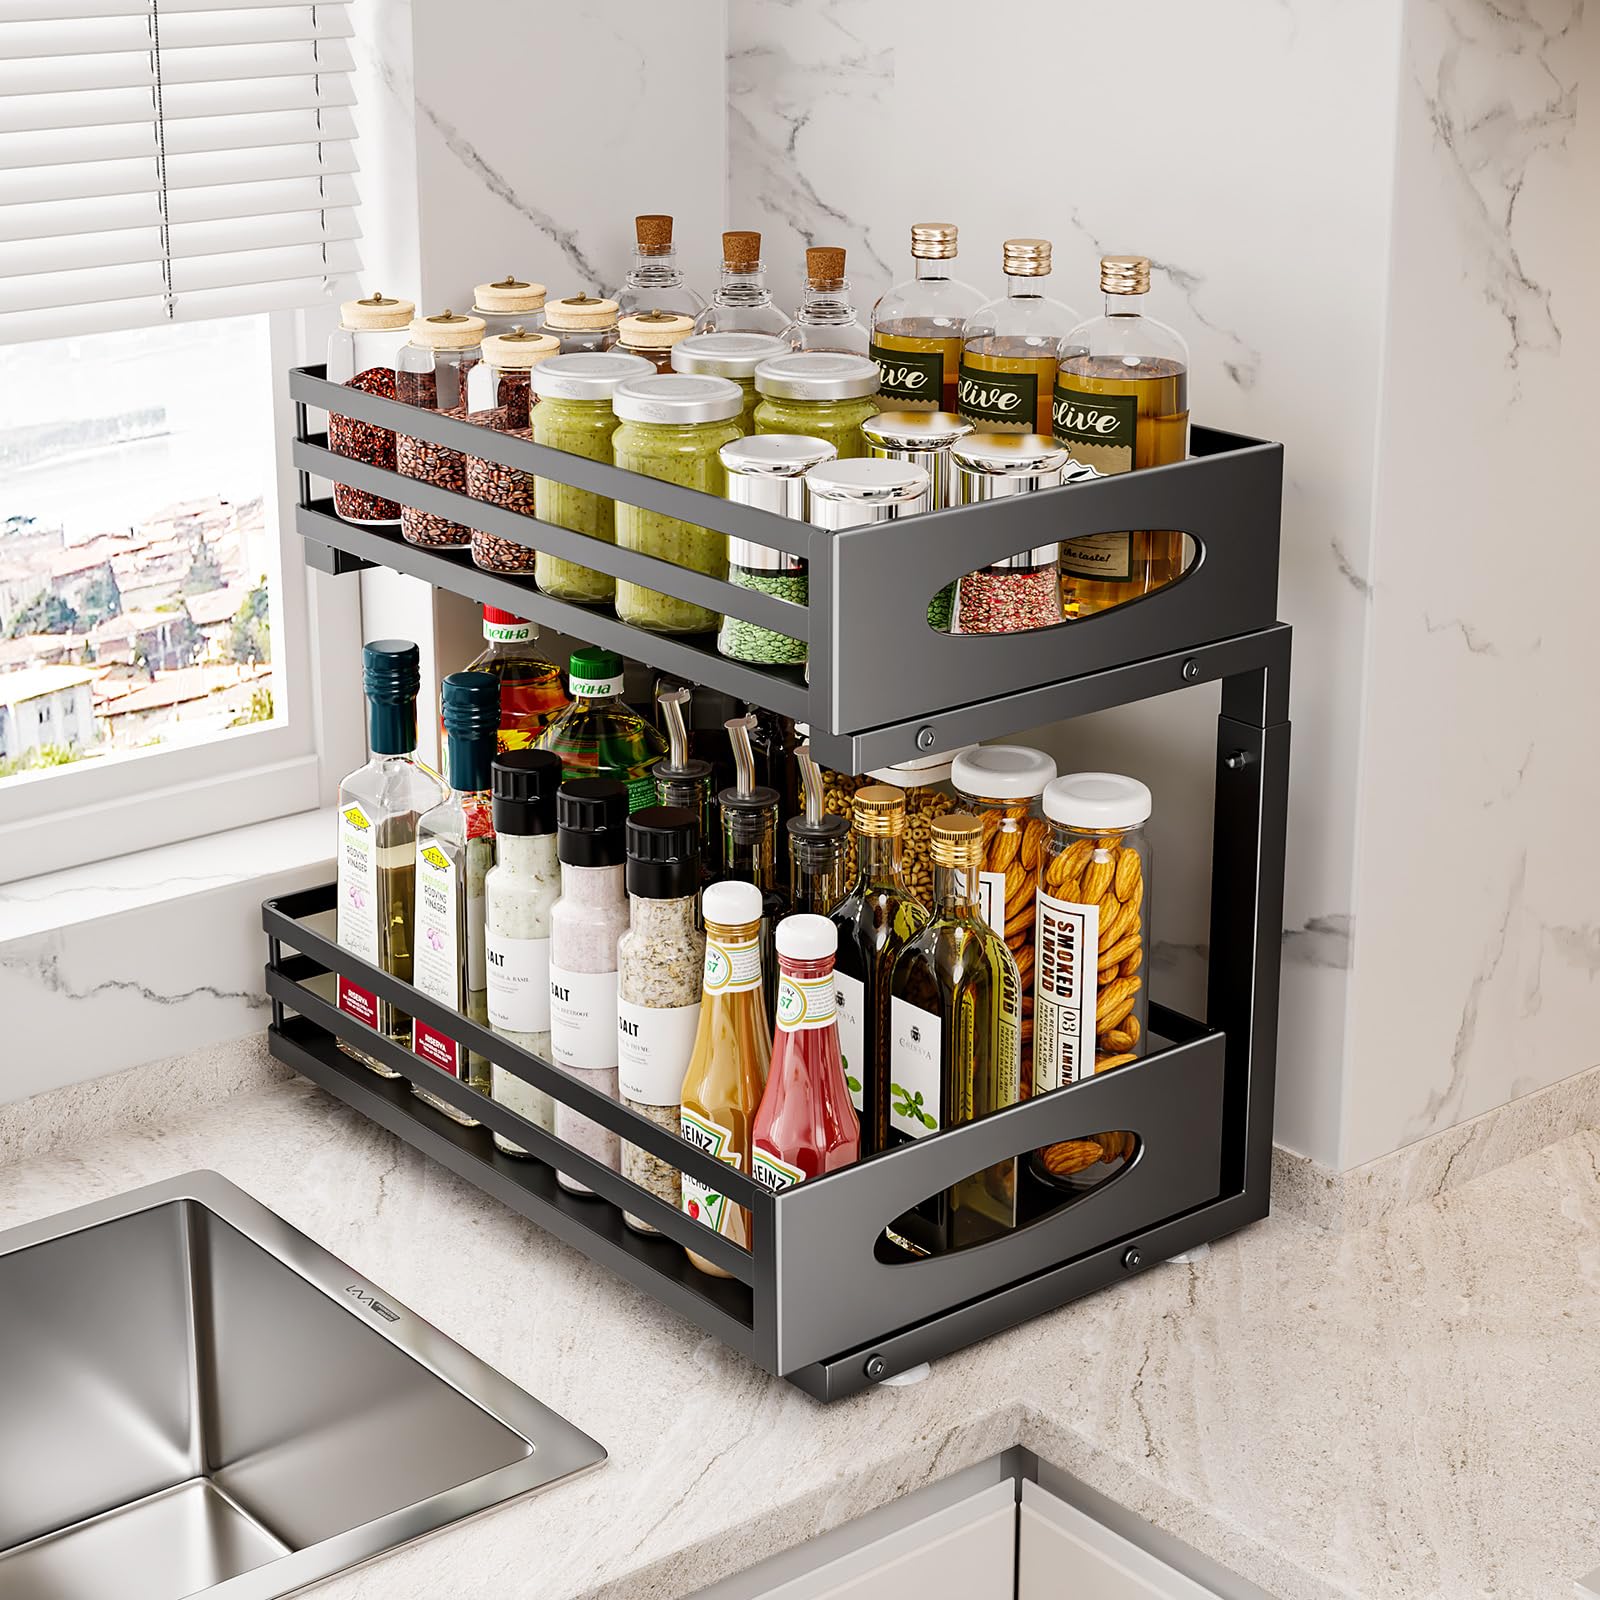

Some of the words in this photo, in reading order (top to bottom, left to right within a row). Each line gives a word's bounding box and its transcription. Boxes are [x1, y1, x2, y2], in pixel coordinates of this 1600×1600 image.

[1053, 402, 1121, 434] olive
[1078, 551, 1112, 563] taste!
[427, 850, 445, 865] ZETA
[1041, 913, 1056, 993] ALMOND
[1056, 920, 1075, 998] SMOKED
[707, 960, 719, 973] 57
[780, 996, 793, 1009] 57
[1062, 1011, 1077, 1032] 03
[1061, 1042, 1074, 1087] ALMOND
